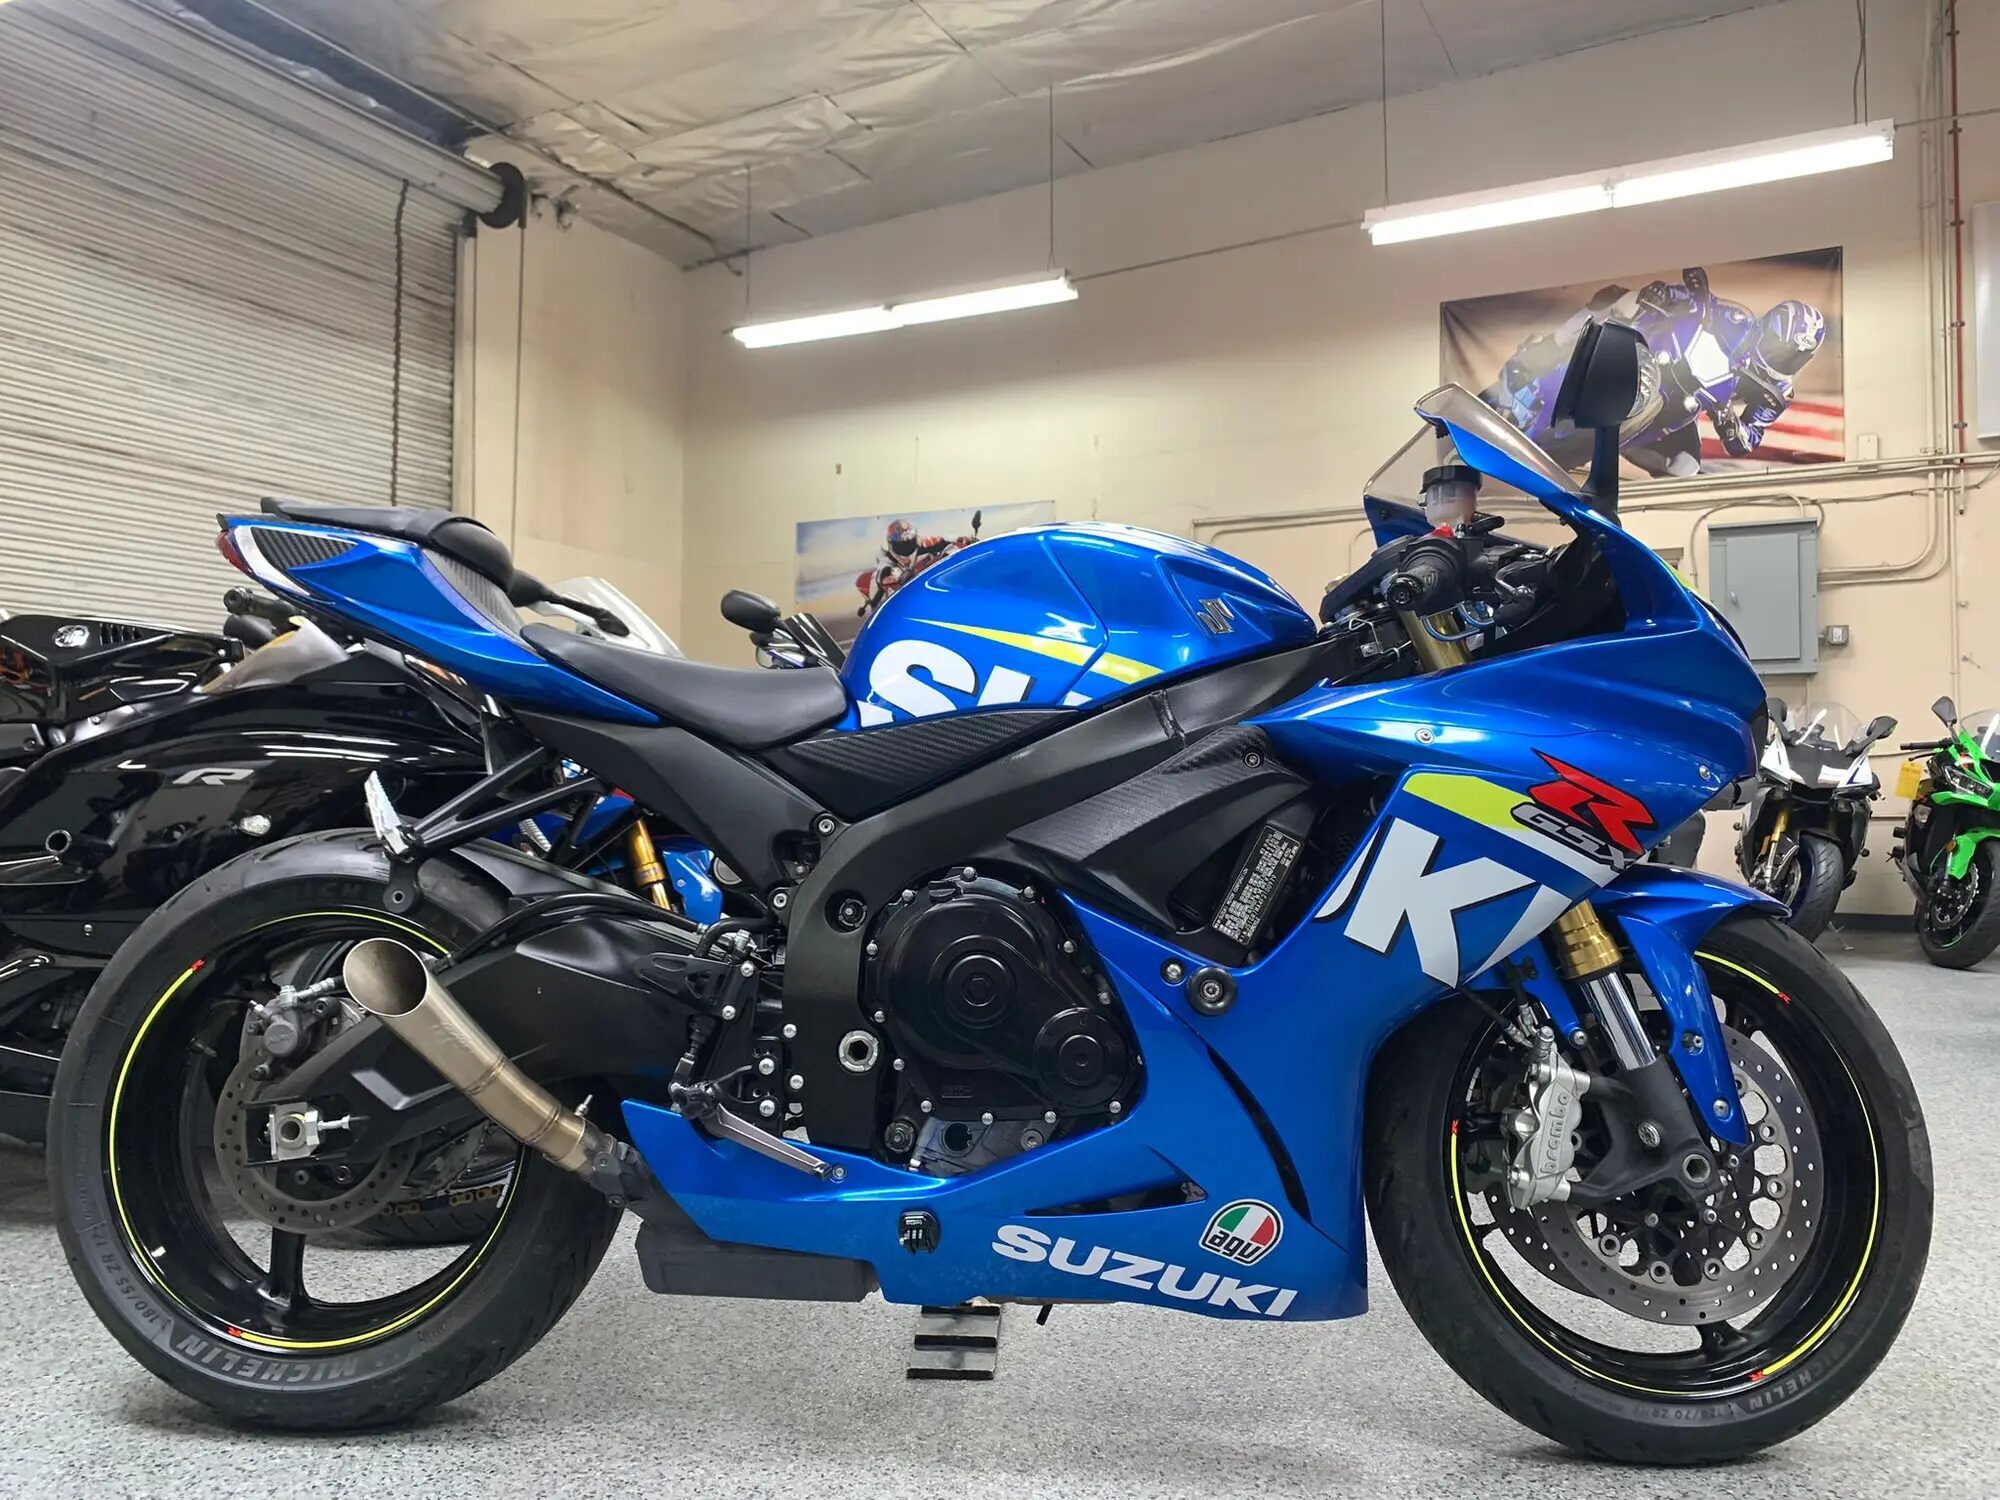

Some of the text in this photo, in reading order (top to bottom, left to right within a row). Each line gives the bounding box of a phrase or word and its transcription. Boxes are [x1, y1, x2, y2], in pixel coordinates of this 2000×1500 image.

[1540, 1092, 1569, 1174] brembo
[103, 1254, 121, 1274] ZR
[1208, 1230, 1262, 1259] agv
[992, 1222, 1299, 1318] SUZUKI
[114, 1277, 162, 1323] 180/55
[174, 1333, 358, 1384] MICHELIN
[1650, 1407, 1668, 1419] ZR
